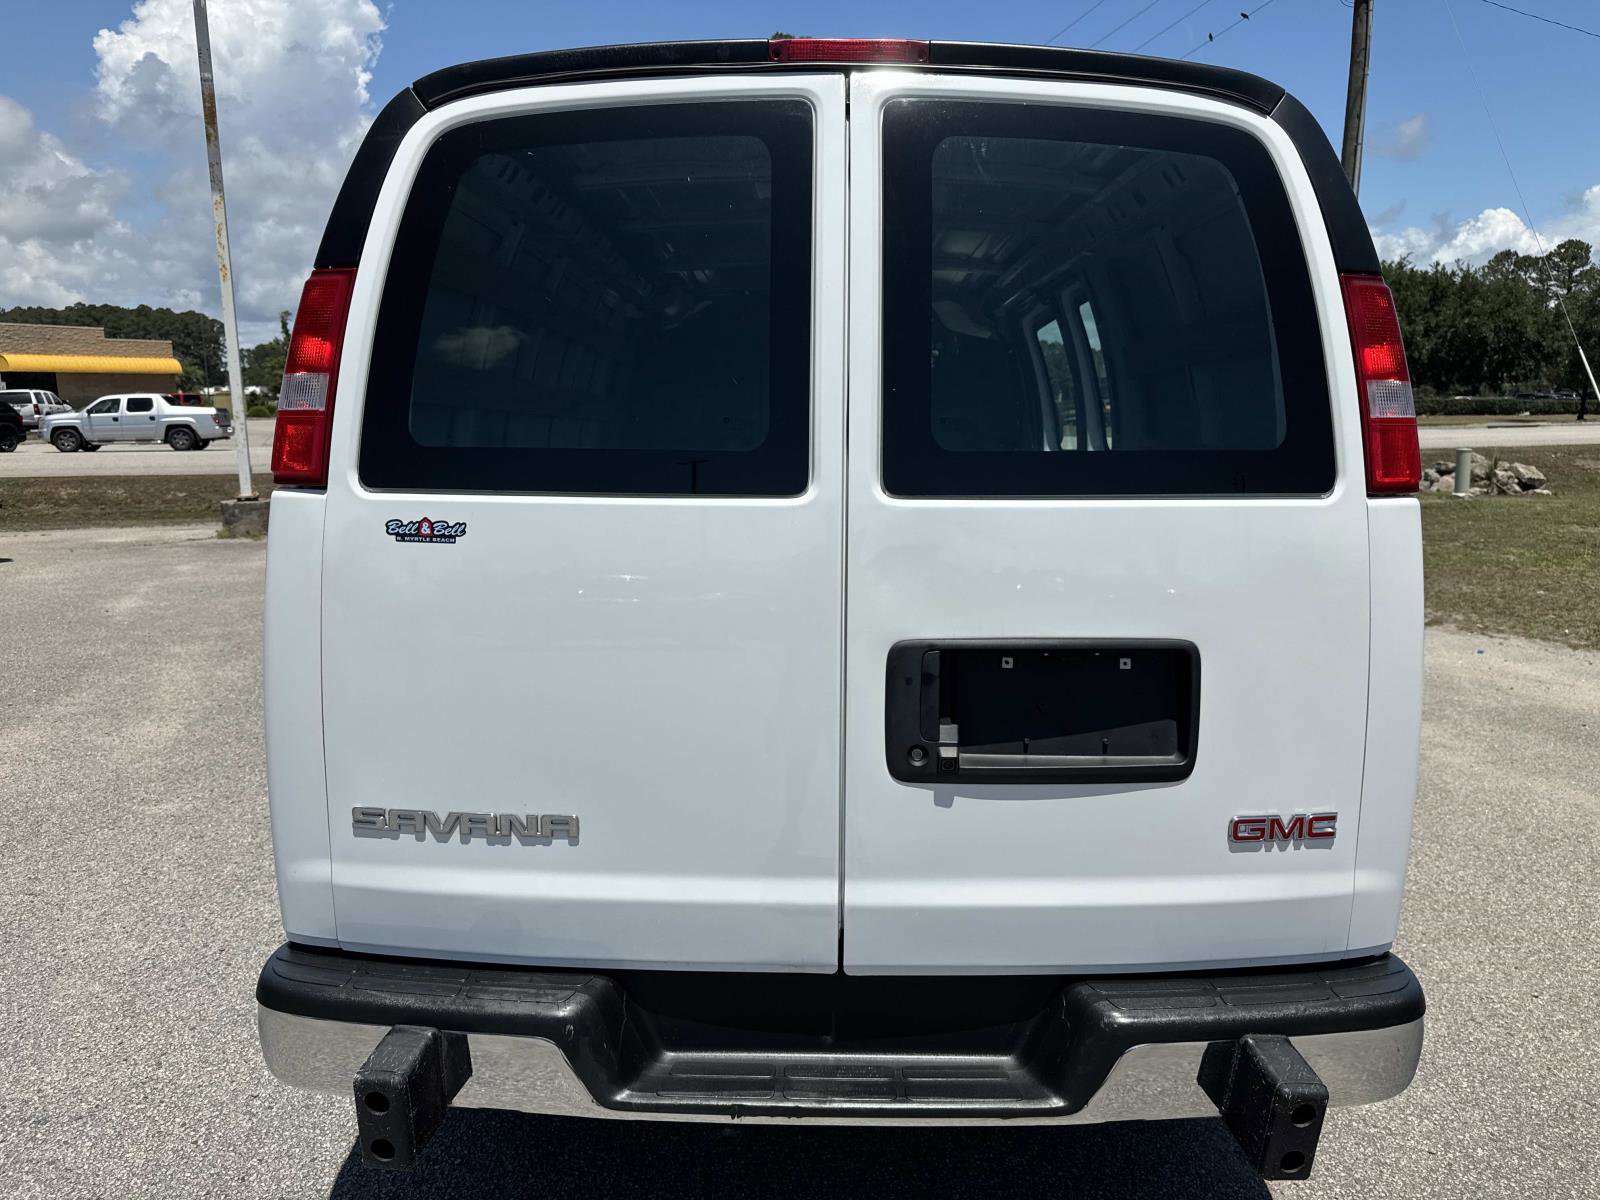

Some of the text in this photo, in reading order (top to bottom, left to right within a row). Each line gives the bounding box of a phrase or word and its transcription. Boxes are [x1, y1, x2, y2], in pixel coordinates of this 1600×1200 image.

[387, 520, 465, 535] Bell & Bell
[352, 806, 579, 838] SAVANA
[1228, 812, 1338, 842] GMC
